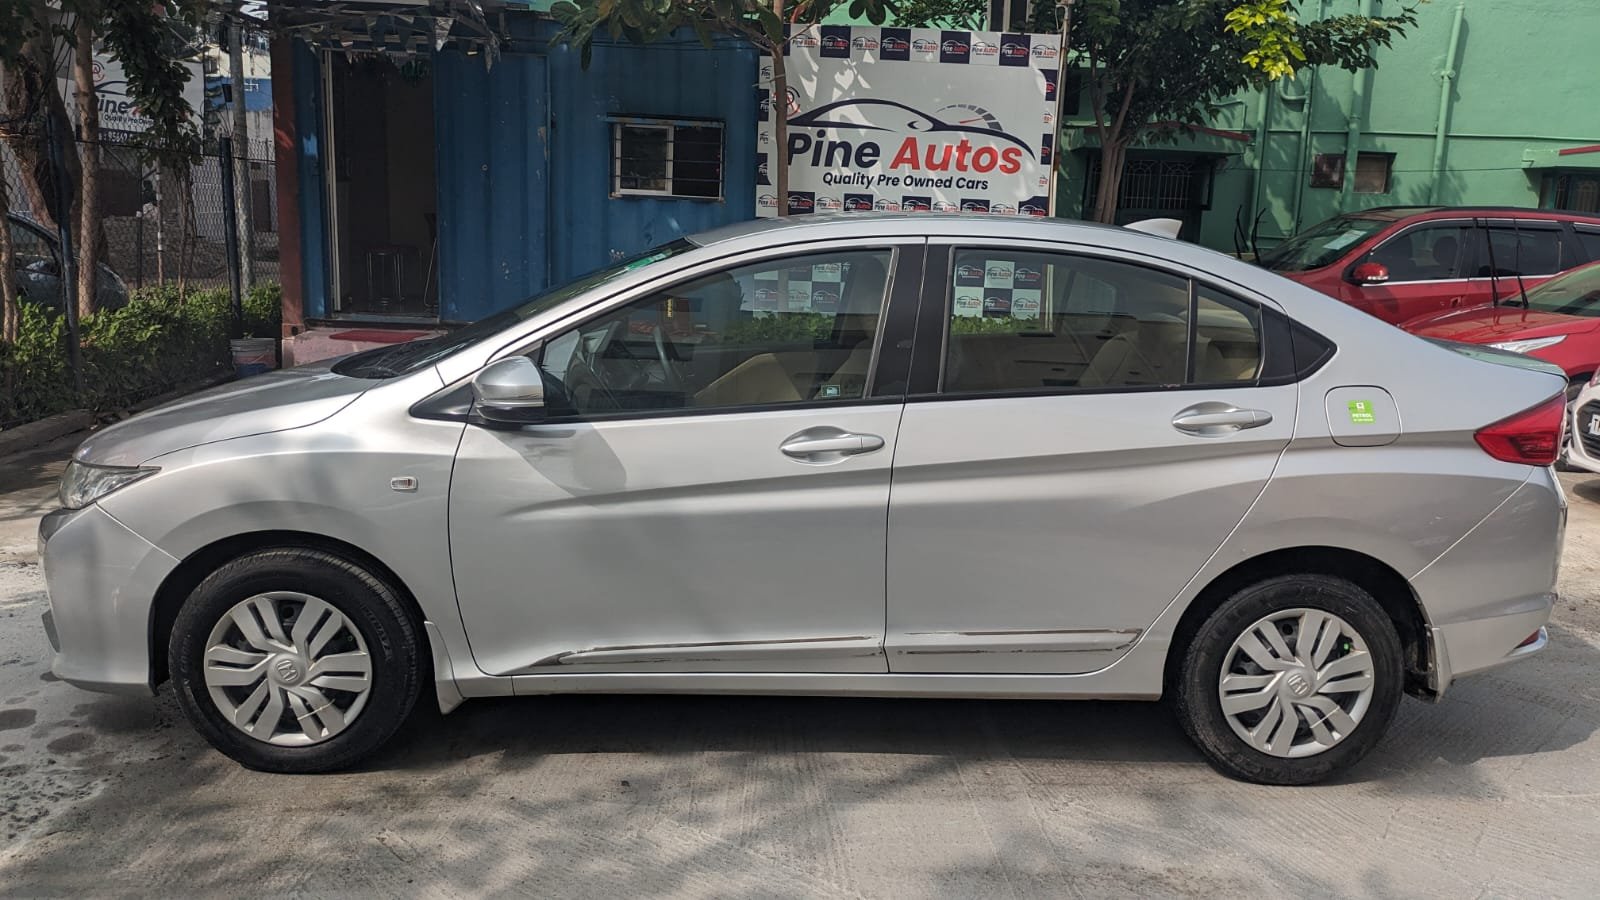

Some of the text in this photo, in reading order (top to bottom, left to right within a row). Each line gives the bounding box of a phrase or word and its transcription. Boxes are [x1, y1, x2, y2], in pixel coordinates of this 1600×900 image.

[98, 94, 128, 113] ine
[787, 129, 1023, 174] Pine Autos
[822, 172, 989, 190] Quality Pre Owned Cars
